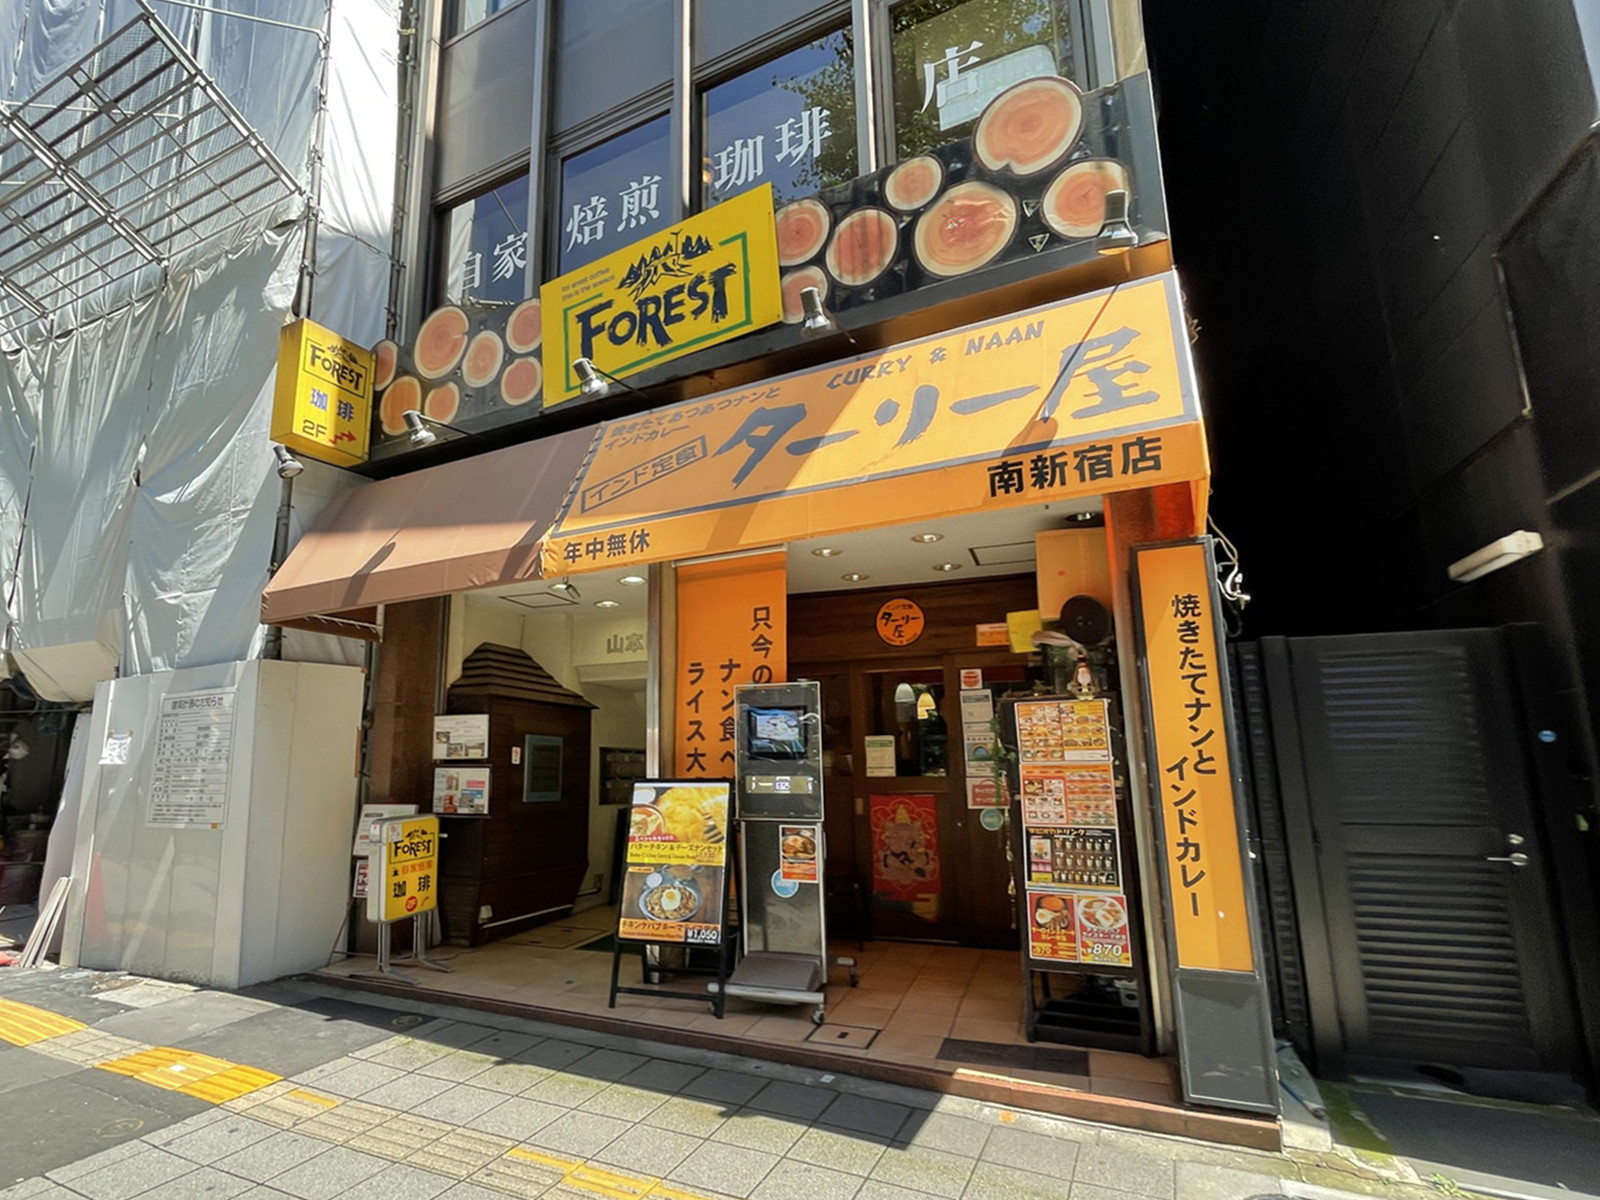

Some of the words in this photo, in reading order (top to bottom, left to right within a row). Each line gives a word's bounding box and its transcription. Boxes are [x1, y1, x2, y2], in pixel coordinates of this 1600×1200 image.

[919, 40, 983, 114] 店
[575, 263, 737, 360] FOREST
[310, 344, 363, 390] FOREST
[826, 355, 912, 390] CURRY
[929, 347, 947, 364] &
[965, 320, 1045, 356] NAAN
[310, 387, 354, 422] 珈琲
[712, 326, 1161, 489] ターリー屋
[302, 419, 327, 438] 2F
[605, 425, 690, 450] インドカレー
[588, 444, 698, 502] インド定食
[987, 436, 1162, 497] 南新宿店
[563, 528, 650, 563] 年中無休
[880, 611, 920, 627] ターリー
[1171, 593, 1217, 775] 焼きたてナンと
[393, 840, 432, 857] FOREST
[1166, 756, 1206, 917] インドカレー
[393, 874, 430, 897] 珈琲
[687, 929, 717, 940] ¥1,050
